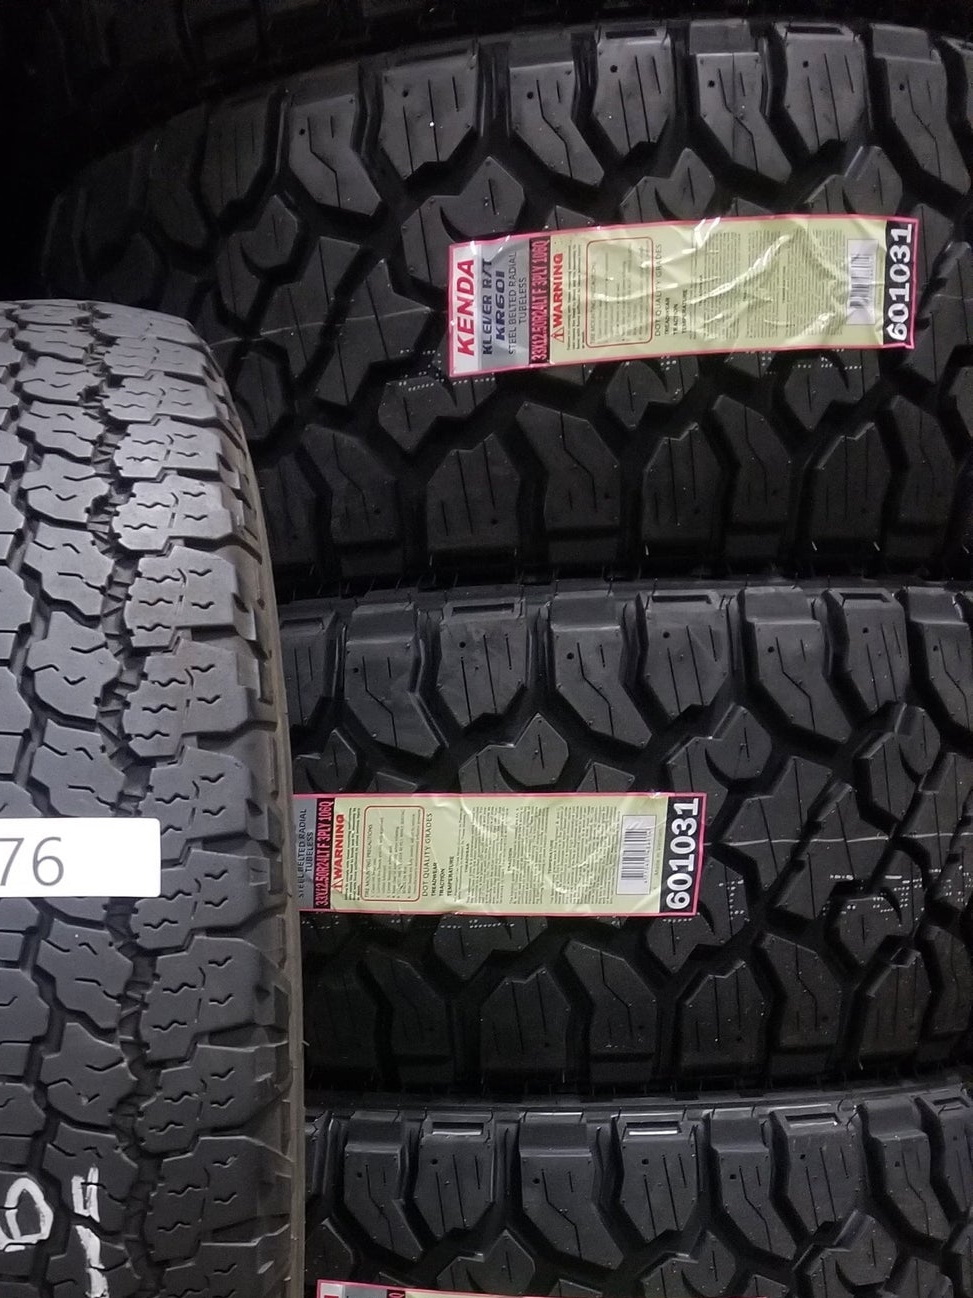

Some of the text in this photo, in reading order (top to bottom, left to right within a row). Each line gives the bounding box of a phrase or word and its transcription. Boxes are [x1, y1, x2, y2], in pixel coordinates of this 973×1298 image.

[456, 259, 475, 356] KENDA
[482, 258, 493, 355] KLEVER R/T
[508, 251, 517, 354] STEEL BELTED RADIAL
[519, 277, 527, 323] TUBELESS
[552, 253, 564, 328] WARNING
[886, 224, 911, 341] 601031
[654, 319, 662, 336] DOT
[299, 809, 307, 839] RADIAL
[305, 832, 313, 872] TUBELESS
[333, 814, 344, 880] WARNING
[425, 813, 433, 843] GRADES
[297, 842, 305, 872] BELTED
[423, 846, 431, 878] QUALITY
[666, 798, 699, 910] 601031
